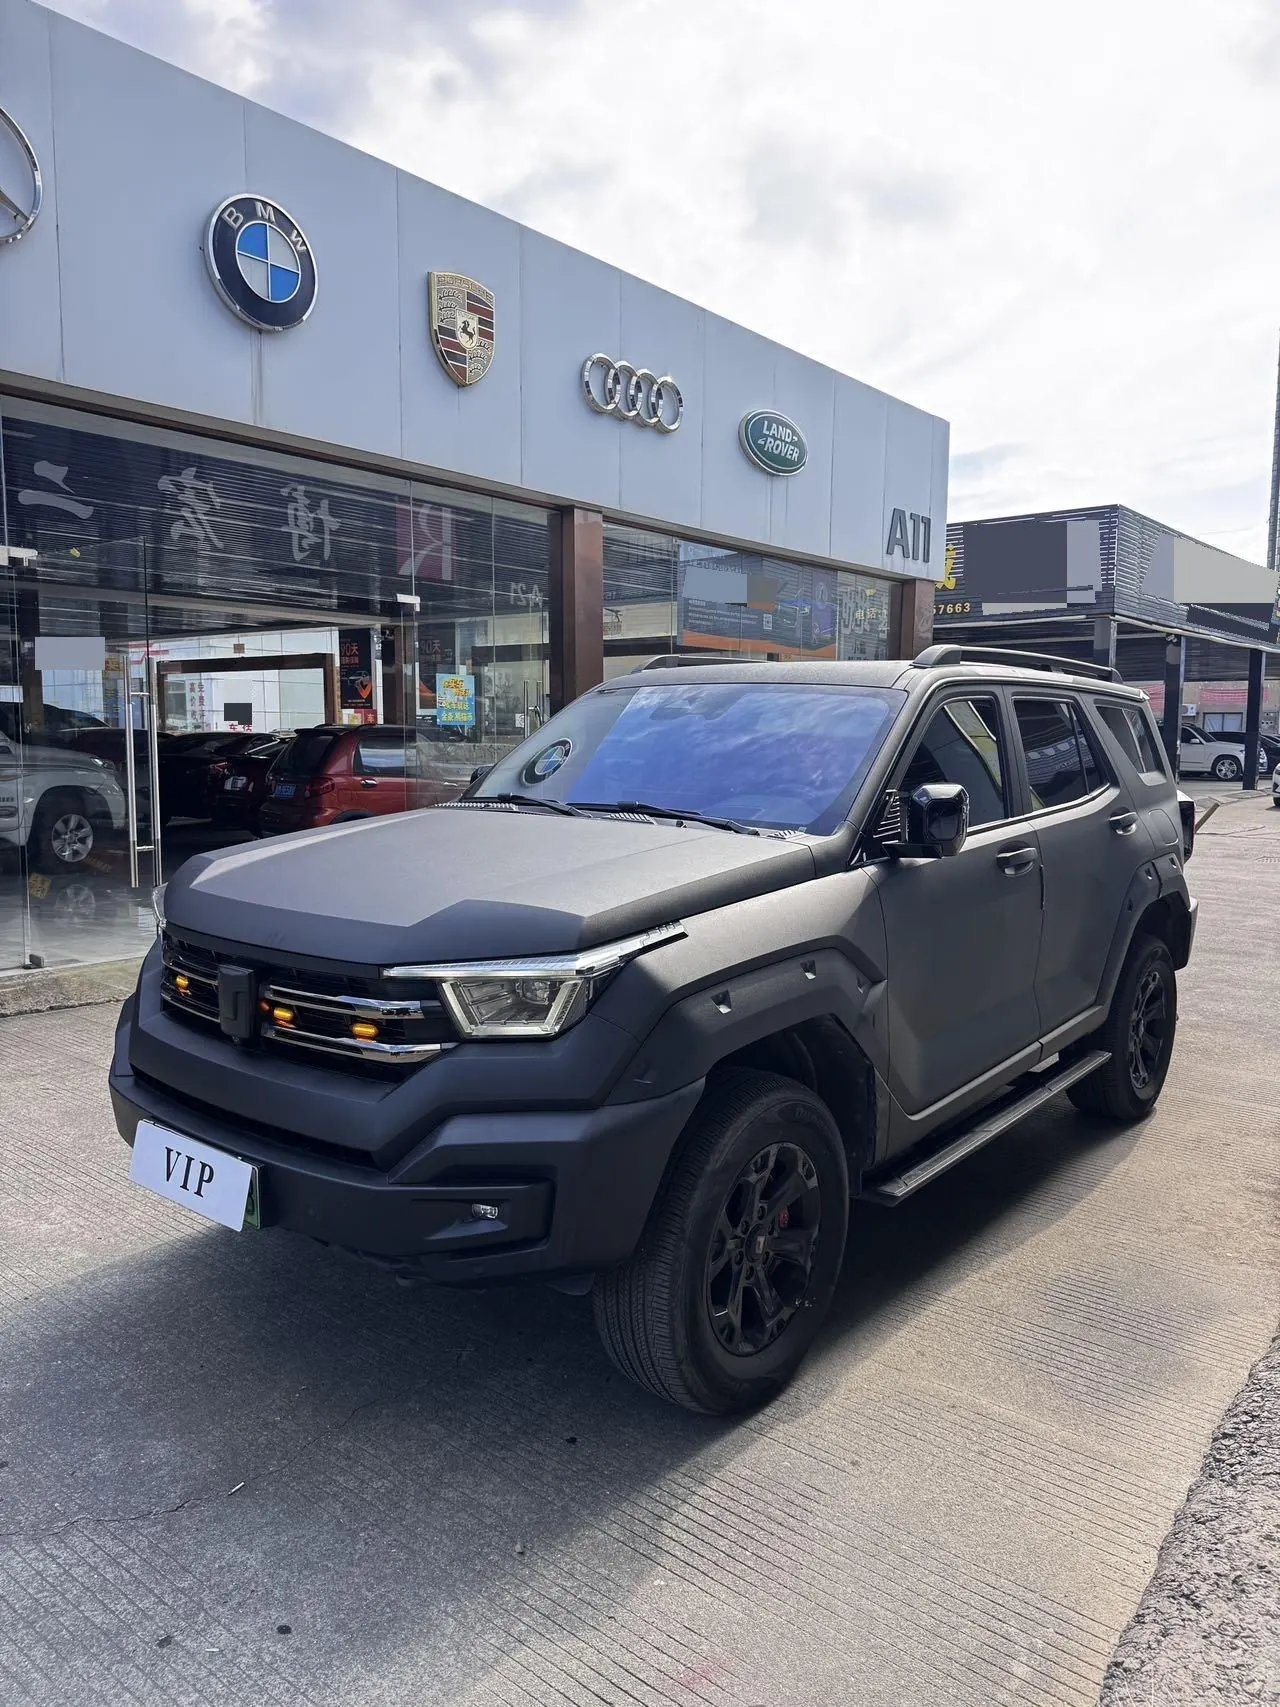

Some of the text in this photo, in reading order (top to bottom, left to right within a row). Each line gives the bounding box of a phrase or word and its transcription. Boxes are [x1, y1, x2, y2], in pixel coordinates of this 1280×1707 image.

[222, 201, 307, 253] BMW
[762, 420, 792, 443] LAND
[764, 437, 800, 462] ROVER
[886, 507, 931, 563] A11
[165, 1146, 215, 1198] VIP
